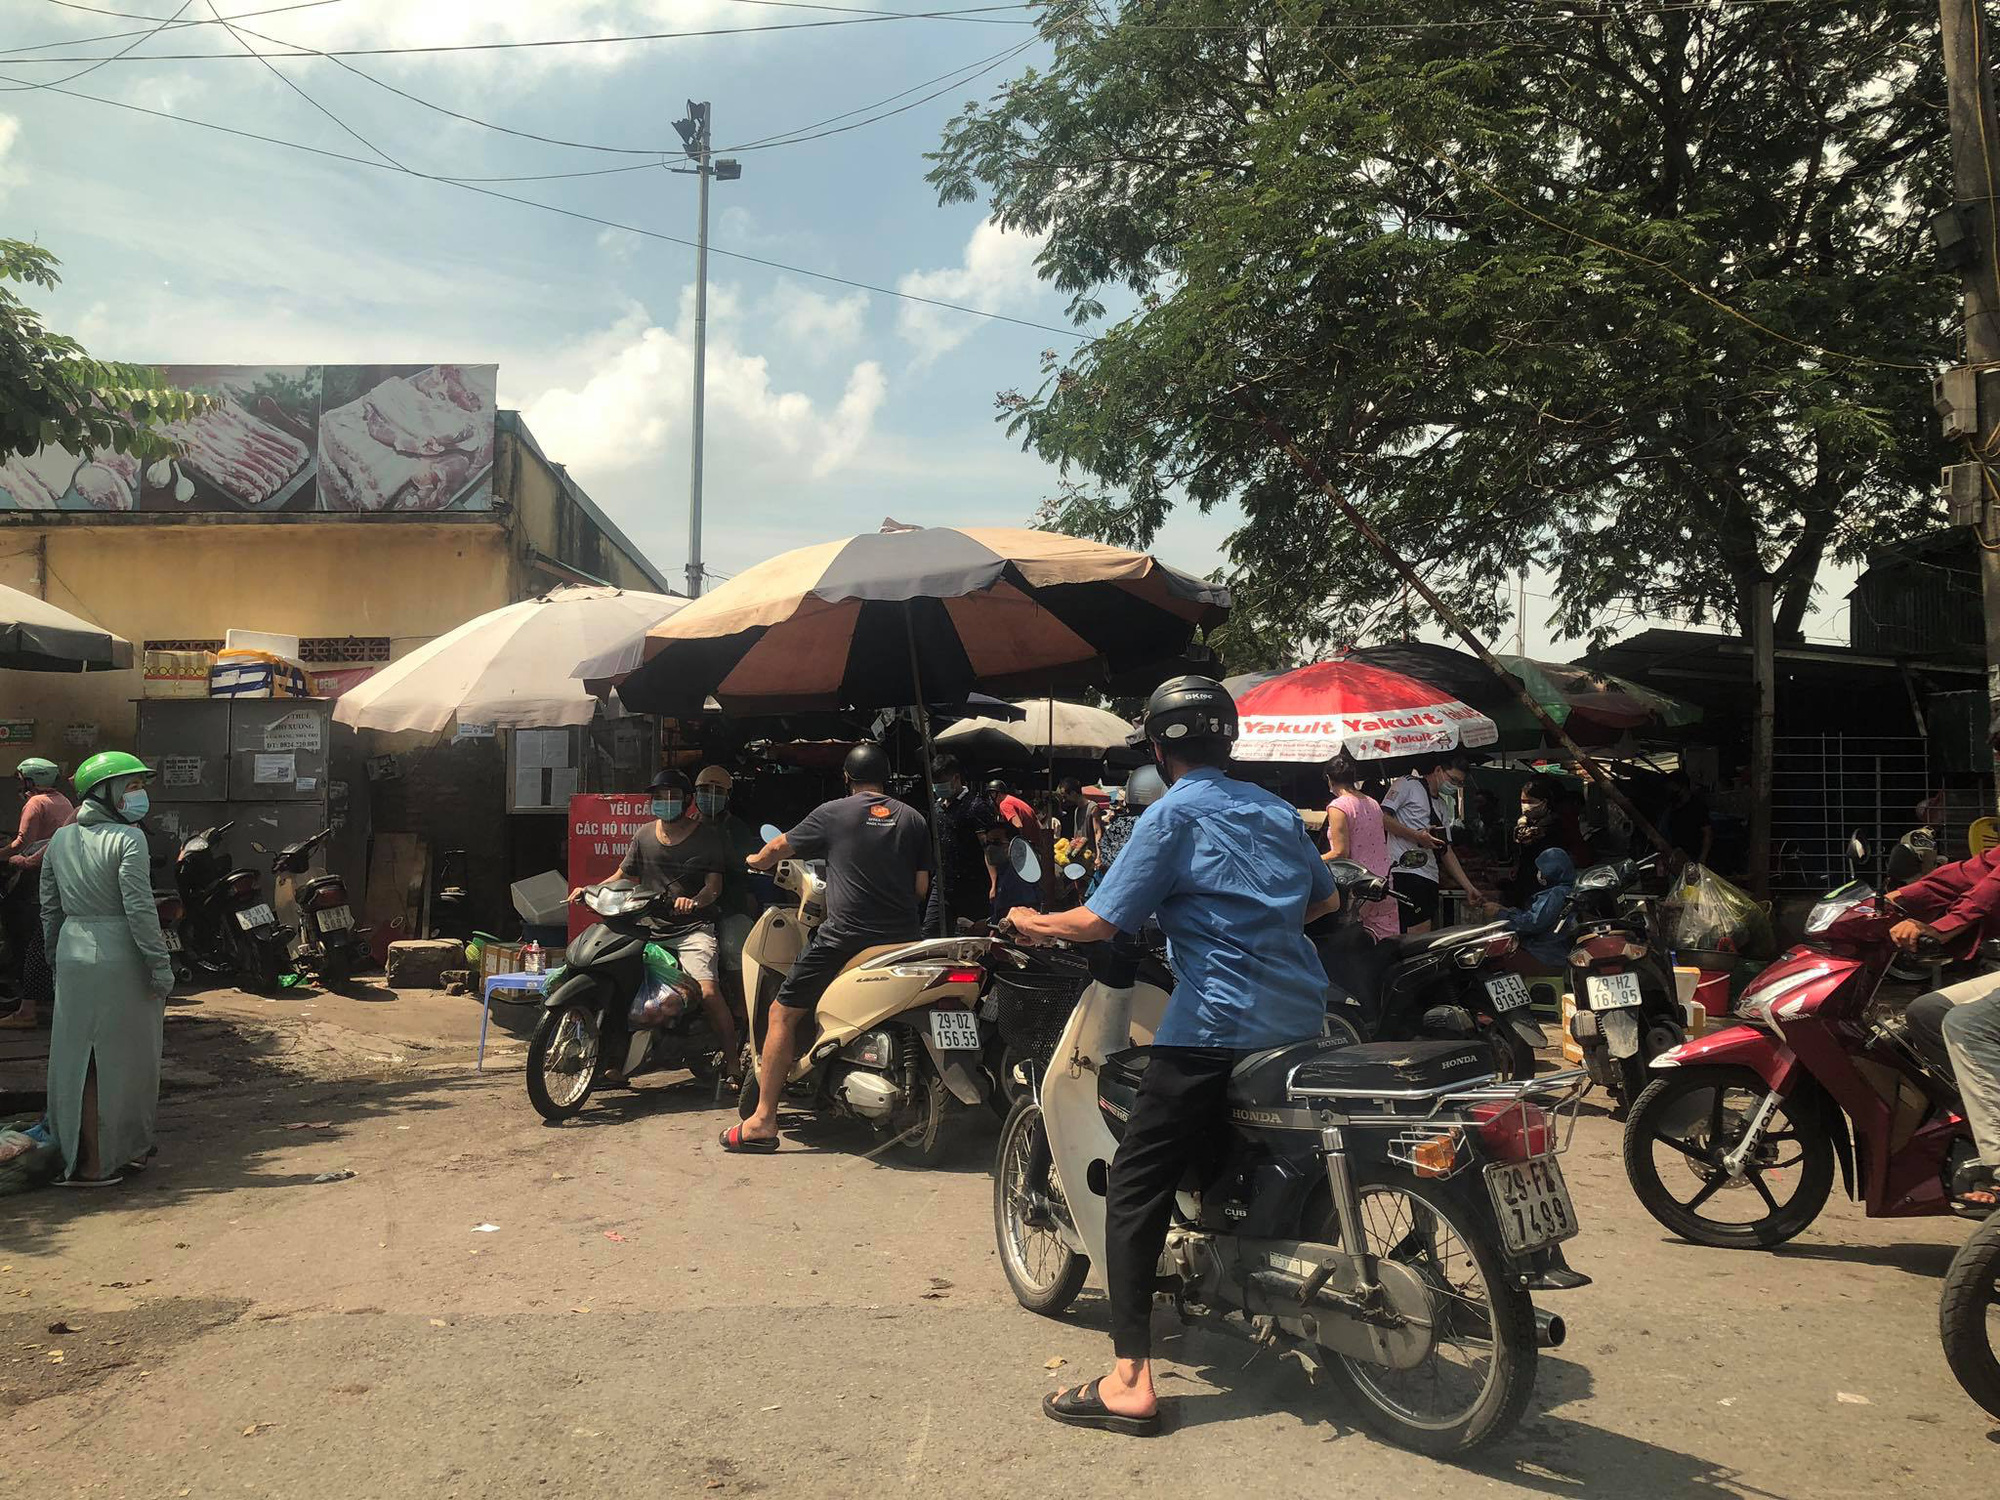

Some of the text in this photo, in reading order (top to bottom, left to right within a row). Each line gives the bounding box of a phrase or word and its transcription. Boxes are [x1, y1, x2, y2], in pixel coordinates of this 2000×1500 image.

[1244, 721, 1337, 735] Yakult
[1342, 713, 1443, 732] Yakult
[1392, 732, 1434, 744] Yakult
[634, 800, 656, 815] CẦ
[575, 820, 643, 837] CÁC HỘ KIN
[594, 841, 609, 855] VÀ
[1491, 976, 1521, 995] 29-E1
[1595, 976, 1631, 992] 29-H2
[1495, 989, 1530, 1010] 919.55
[1594, 989, 1637, 1006] 164.95
[937, 1013, 971, 1029] 29-D2
[1780, 1013, 1811, 1022] HONDA
[937, 1031, 977, 1047] 156.55
[1318, 1037, 1349, 1048] HONDA
[1441, 1055, 1478, 1069] HONDA
[1232, 1109, 1283, 1123] HONDA
[1739, 1103, 1778, 1165] HONDA
[1225, 1208, 1247, 1217] CUB
